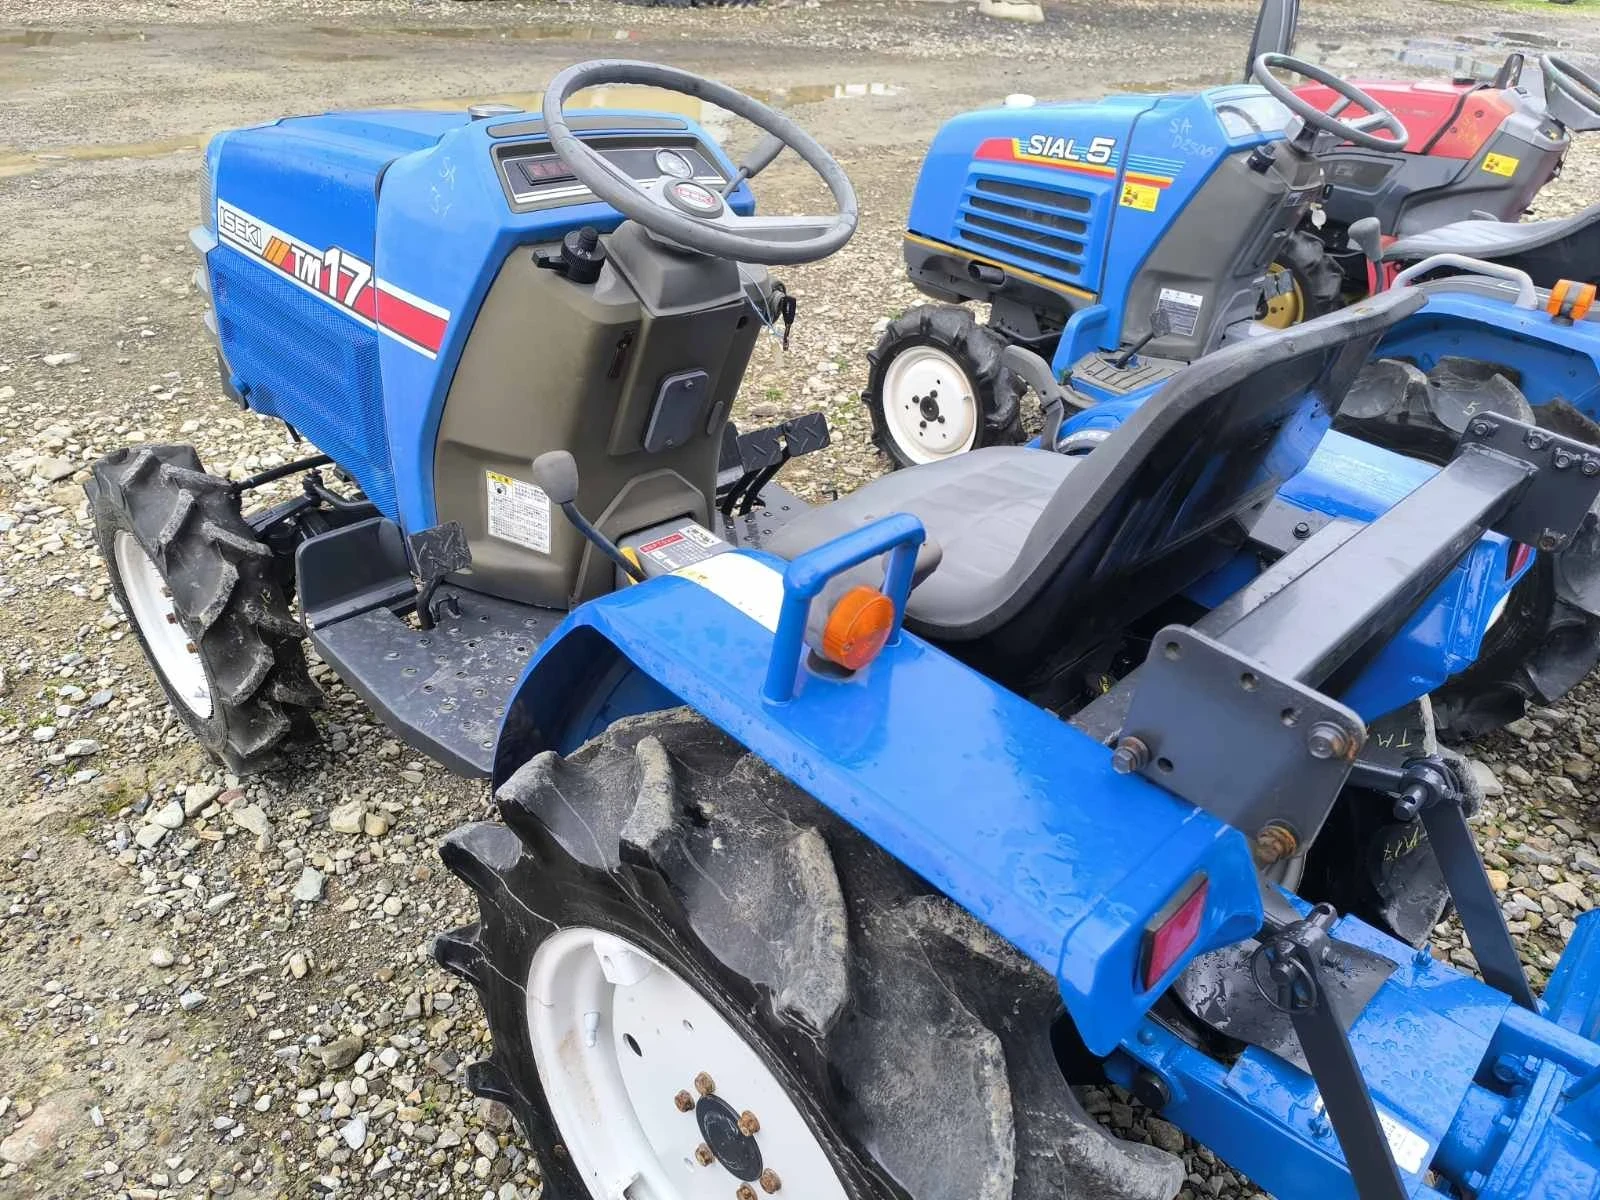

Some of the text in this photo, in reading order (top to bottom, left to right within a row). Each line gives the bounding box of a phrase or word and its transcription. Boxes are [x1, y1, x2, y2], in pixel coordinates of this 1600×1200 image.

[1027, 133, 1117, 165] SIAL 5
[219, 205, 263, 250] ISEKI
